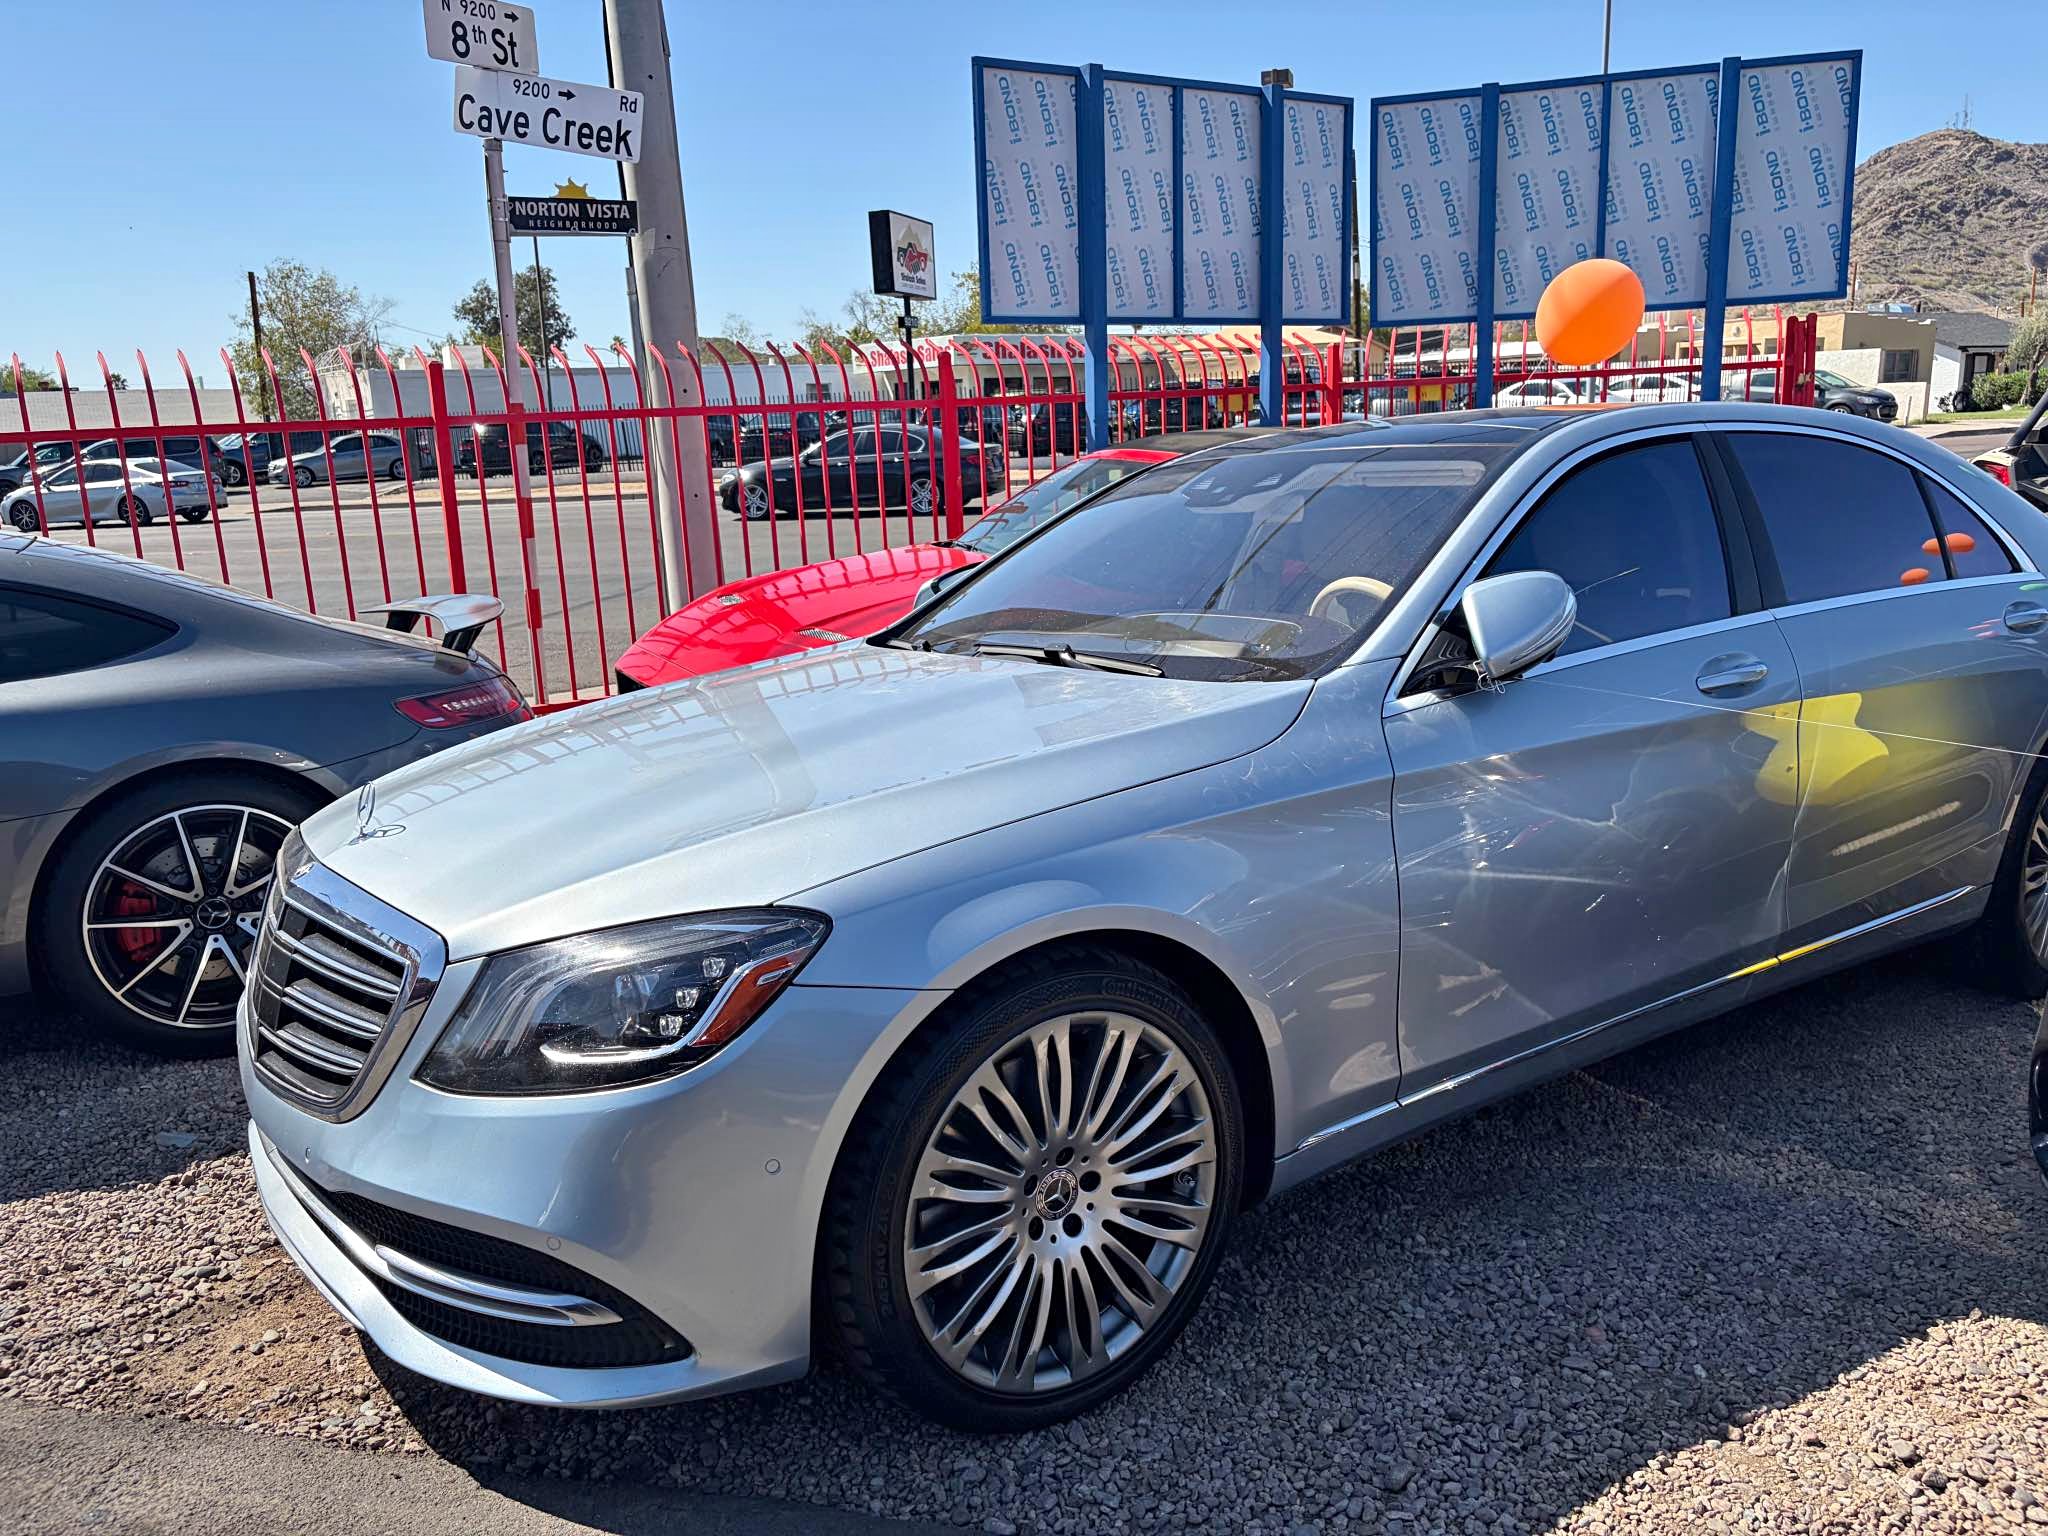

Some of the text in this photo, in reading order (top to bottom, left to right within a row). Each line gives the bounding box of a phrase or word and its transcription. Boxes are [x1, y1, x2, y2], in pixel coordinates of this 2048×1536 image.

[460, 0, 496, 20] 9200
[451, 20, 519, 68] 8th St
[513, 78, 638, 114] 9200 Rd
[458, 94, 633, 158] Cave Creek
[515, 201, 630, 219] NORTON VISTA
[528, 219, 618, 230] NEIGHBORHOOD
